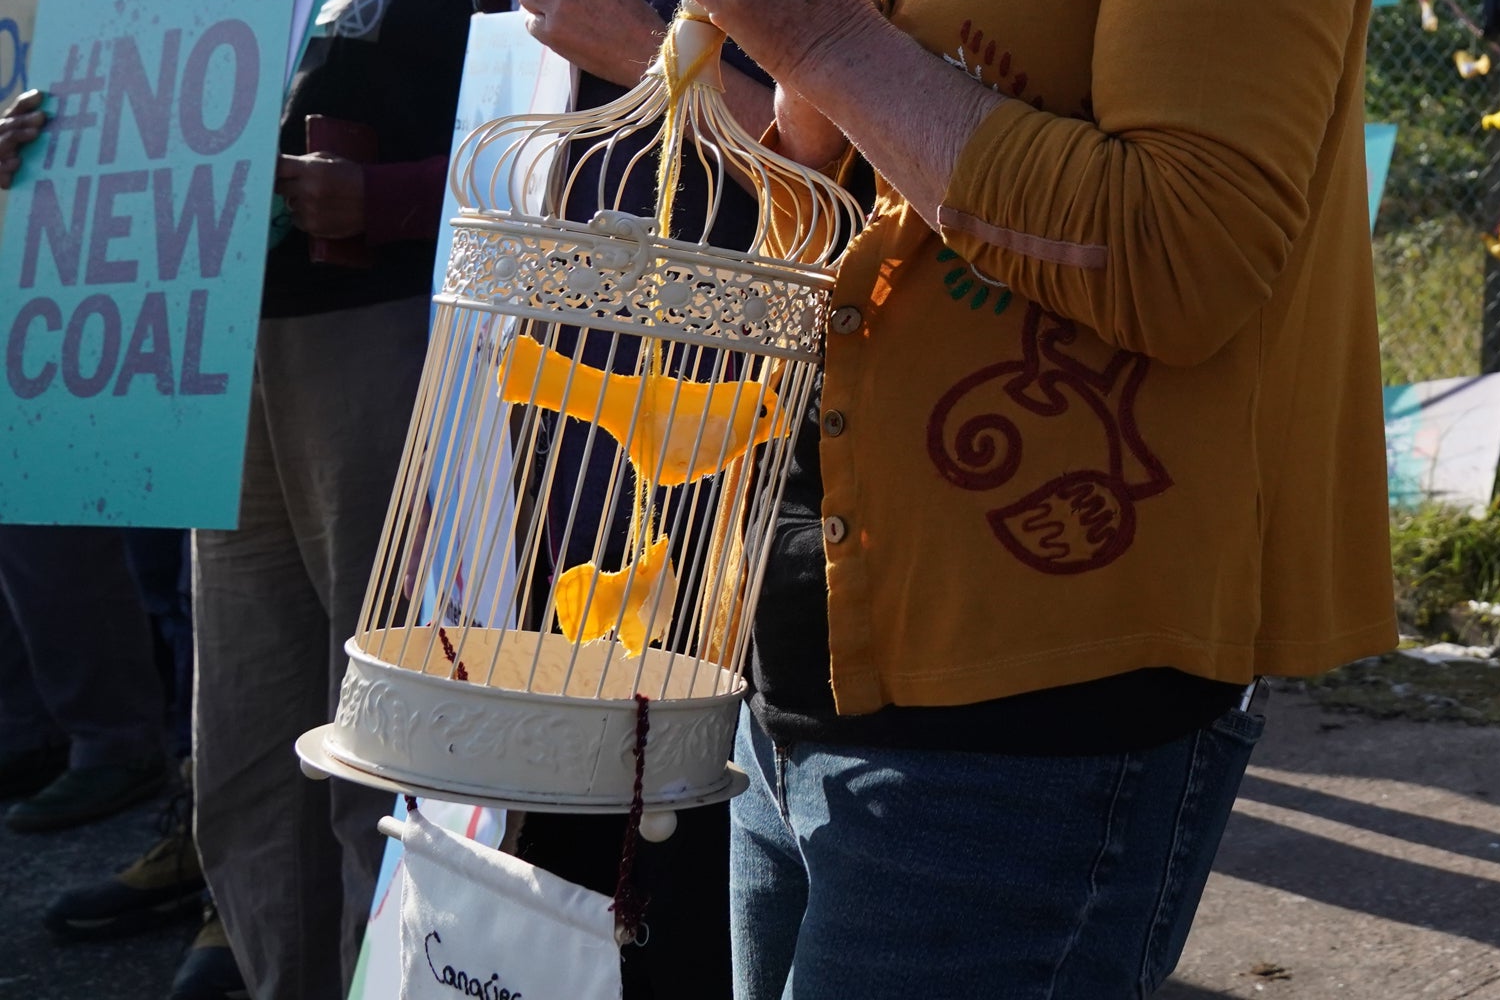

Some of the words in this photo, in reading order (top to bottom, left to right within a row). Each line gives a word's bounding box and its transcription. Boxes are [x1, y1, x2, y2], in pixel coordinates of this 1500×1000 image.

[46, 19, 261, 169] #NO
[19, 159, 252, 289] NEW
[6, 289, 228, 399] COAL
